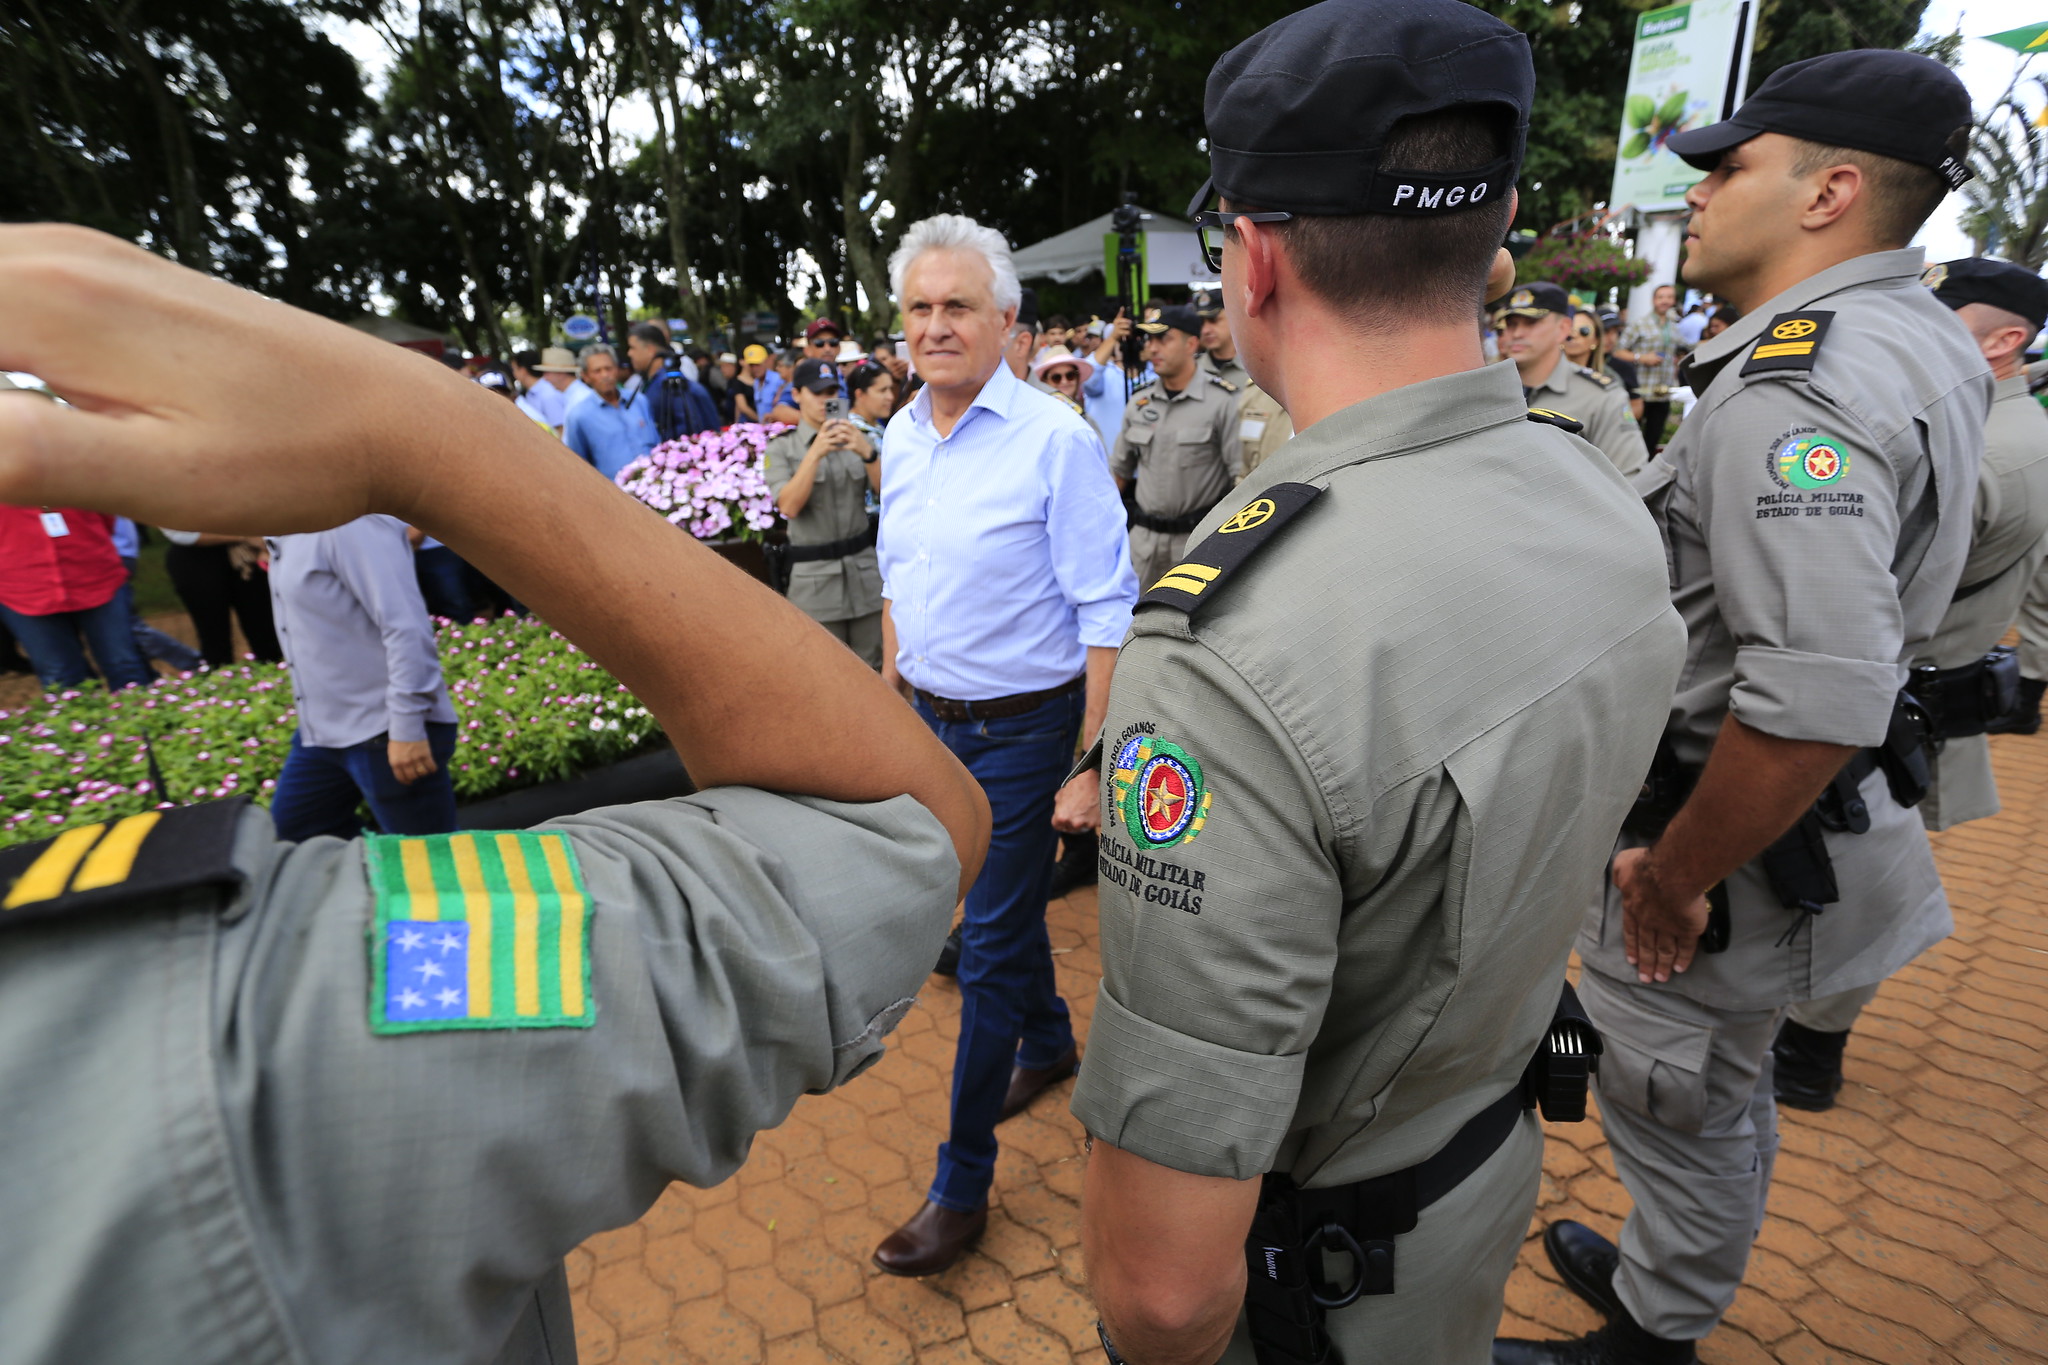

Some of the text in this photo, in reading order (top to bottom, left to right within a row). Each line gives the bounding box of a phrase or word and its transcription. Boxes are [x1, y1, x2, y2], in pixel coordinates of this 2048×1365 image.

[1393, 182, 1487, 209] PMGO
[1757, 490, 1864, 506] POLÍCIA MILITAR
[1756, 504, 1864, 519] ESTADO DE GOIÁS
[1121, 721, 1156, 741] GOIANOS
[1133, 852, 1206, 893] MILITAR
[1129, 874, 1143, 897] DE
[1144, 884, 1203, 915] GOIÁS
